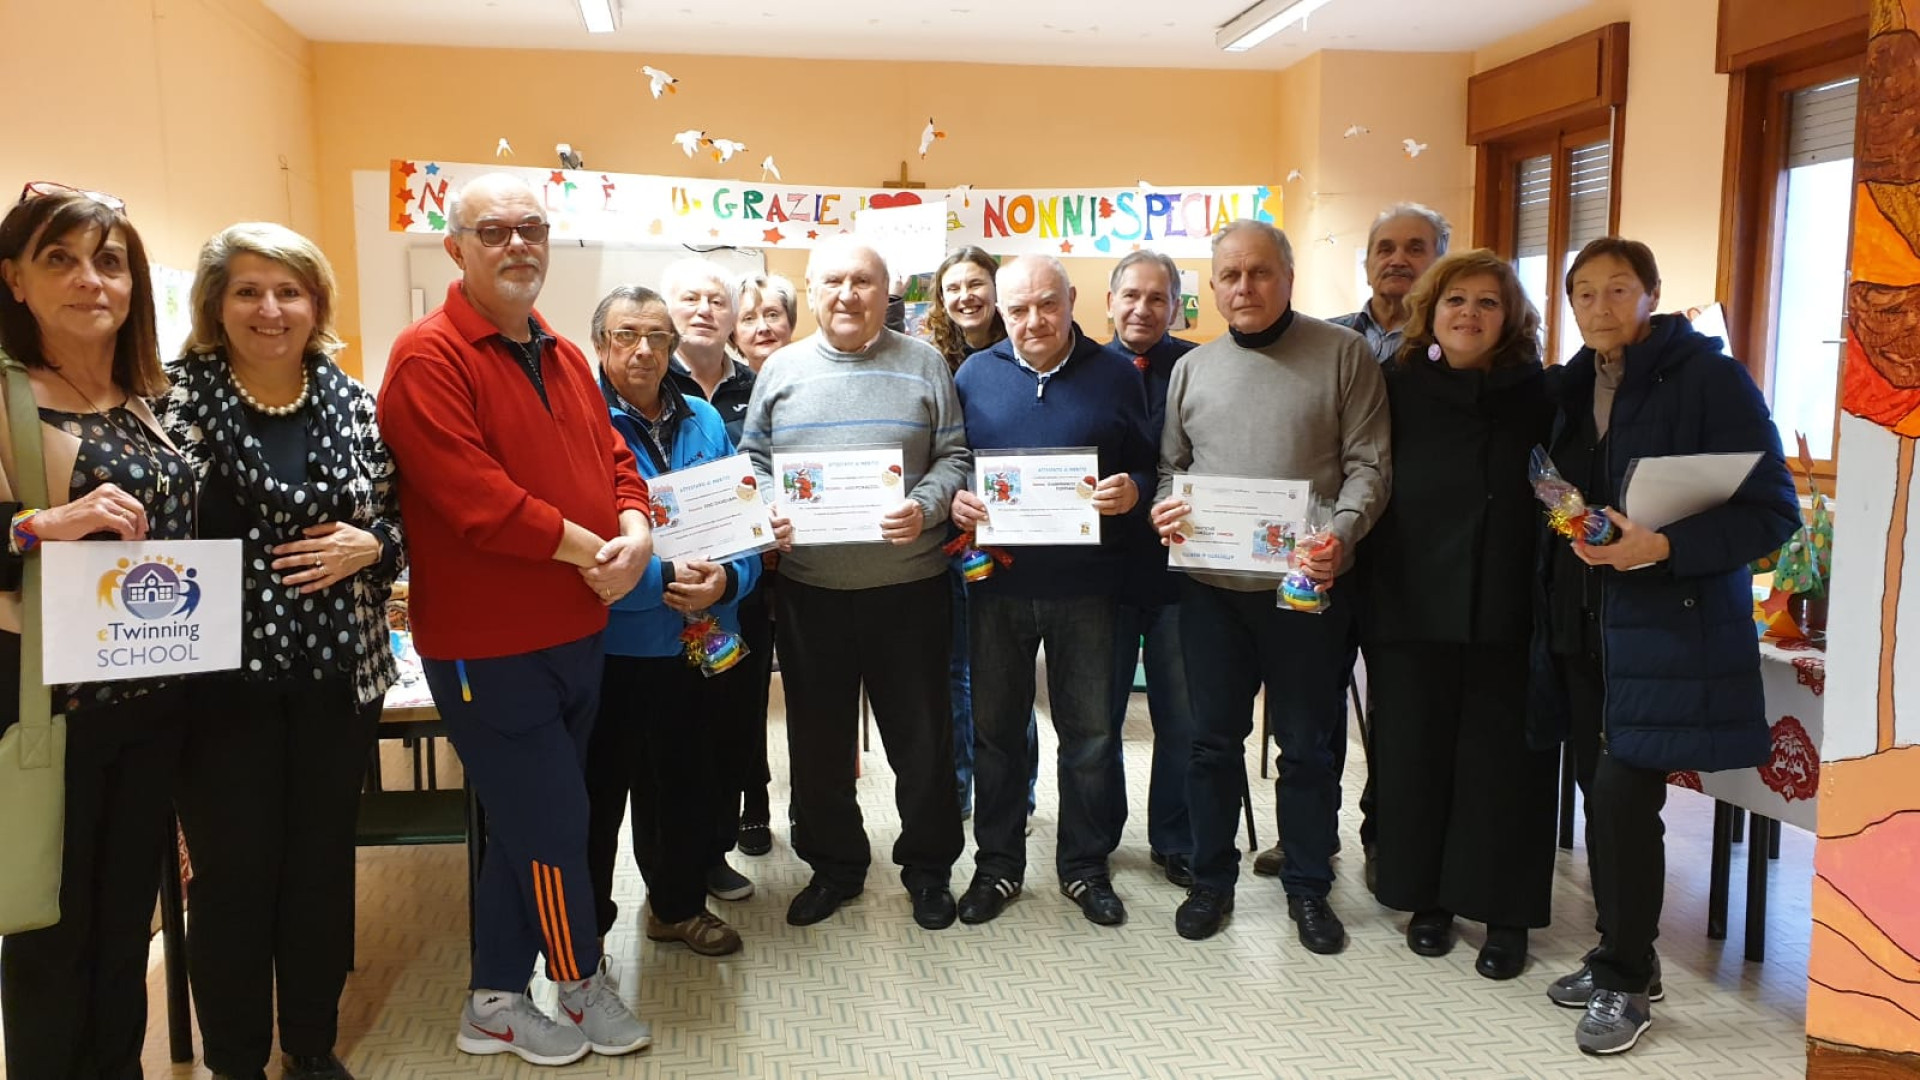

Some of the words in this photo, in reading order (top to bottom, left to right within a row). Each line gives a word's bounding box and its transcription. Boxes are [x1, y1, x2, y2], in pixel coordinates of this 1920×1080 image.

[712, 187, 841, 225] GRAZIE
[983, 194, 1099, 238] NONNI
[97, 620, 200, 642] eTwinning
[97, 643, 200, 668] SCHOOL
